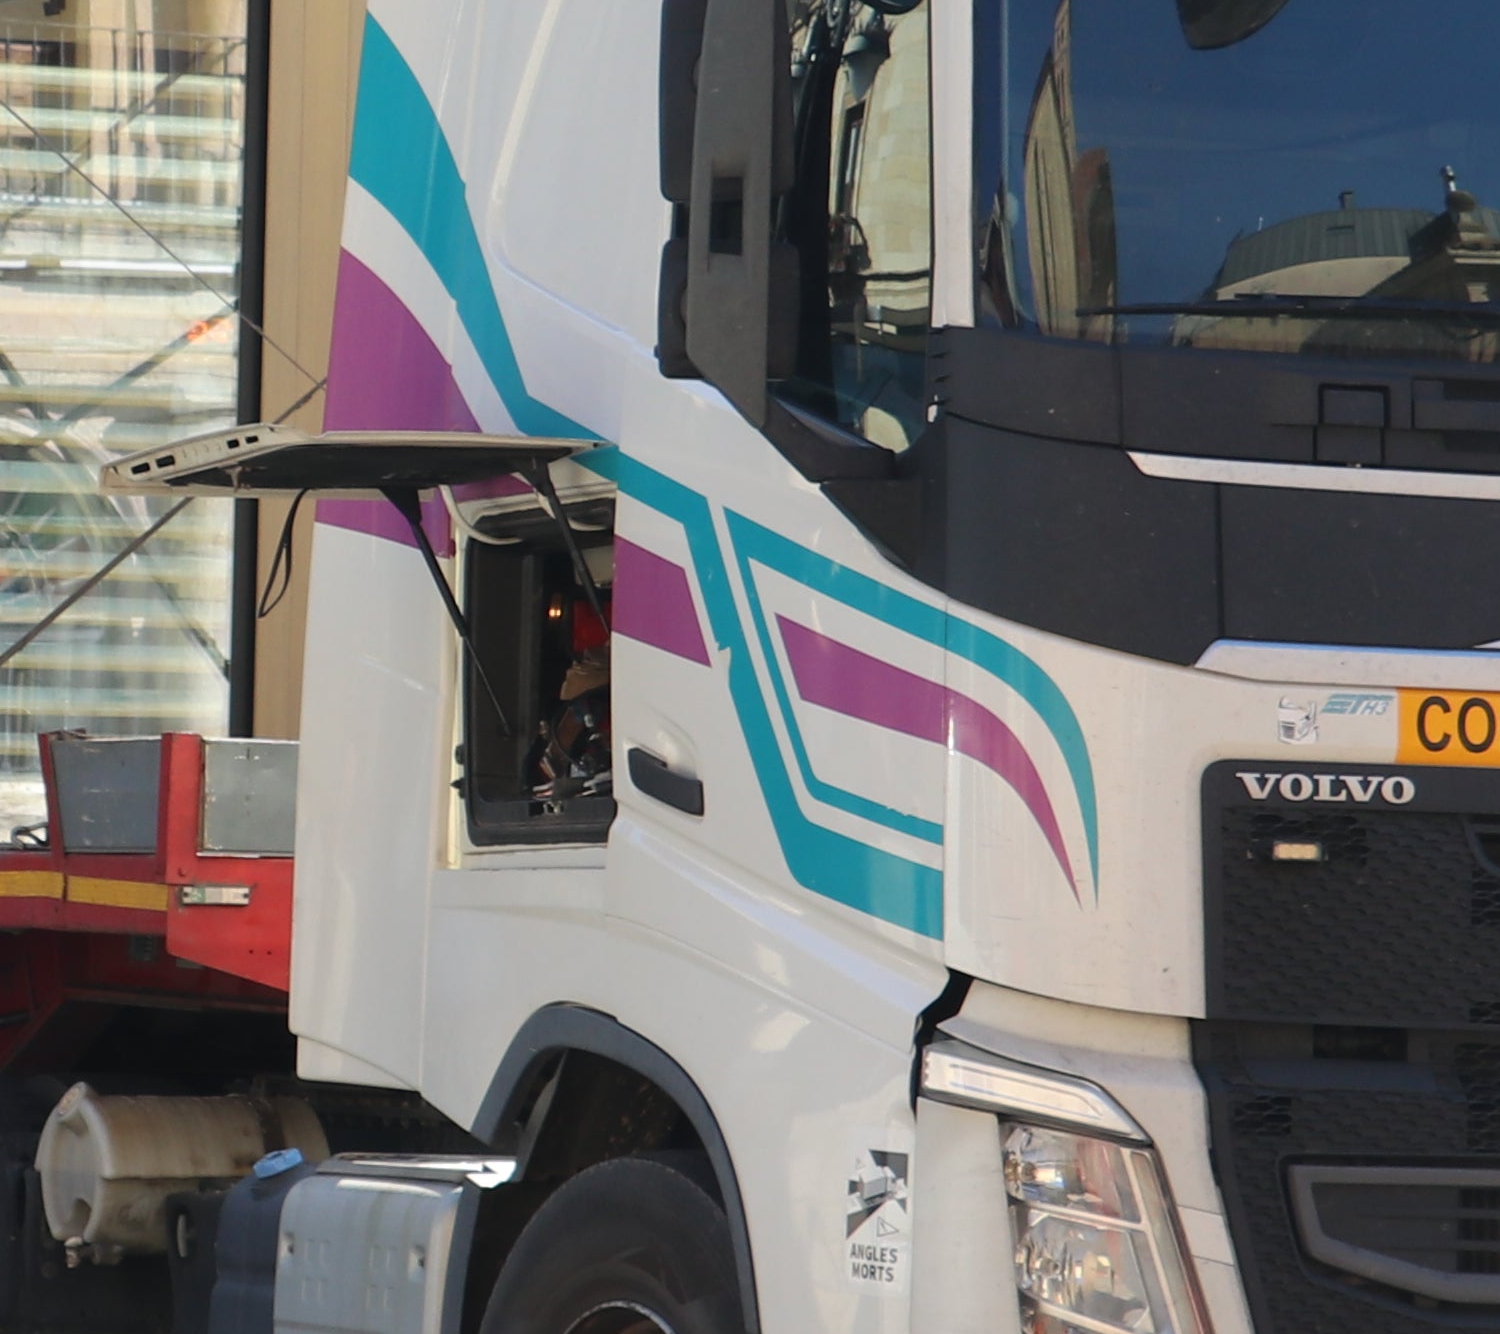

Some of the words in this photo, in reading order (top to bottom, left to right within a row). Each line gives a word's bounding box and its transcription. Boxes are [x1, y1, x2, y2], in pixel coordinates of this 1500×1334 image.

[1235, 771, 1416, 804] VOLVO
[849, 1243, 899, 1264] ANGLES
[851, 1262, 895, 1283] MORTS
